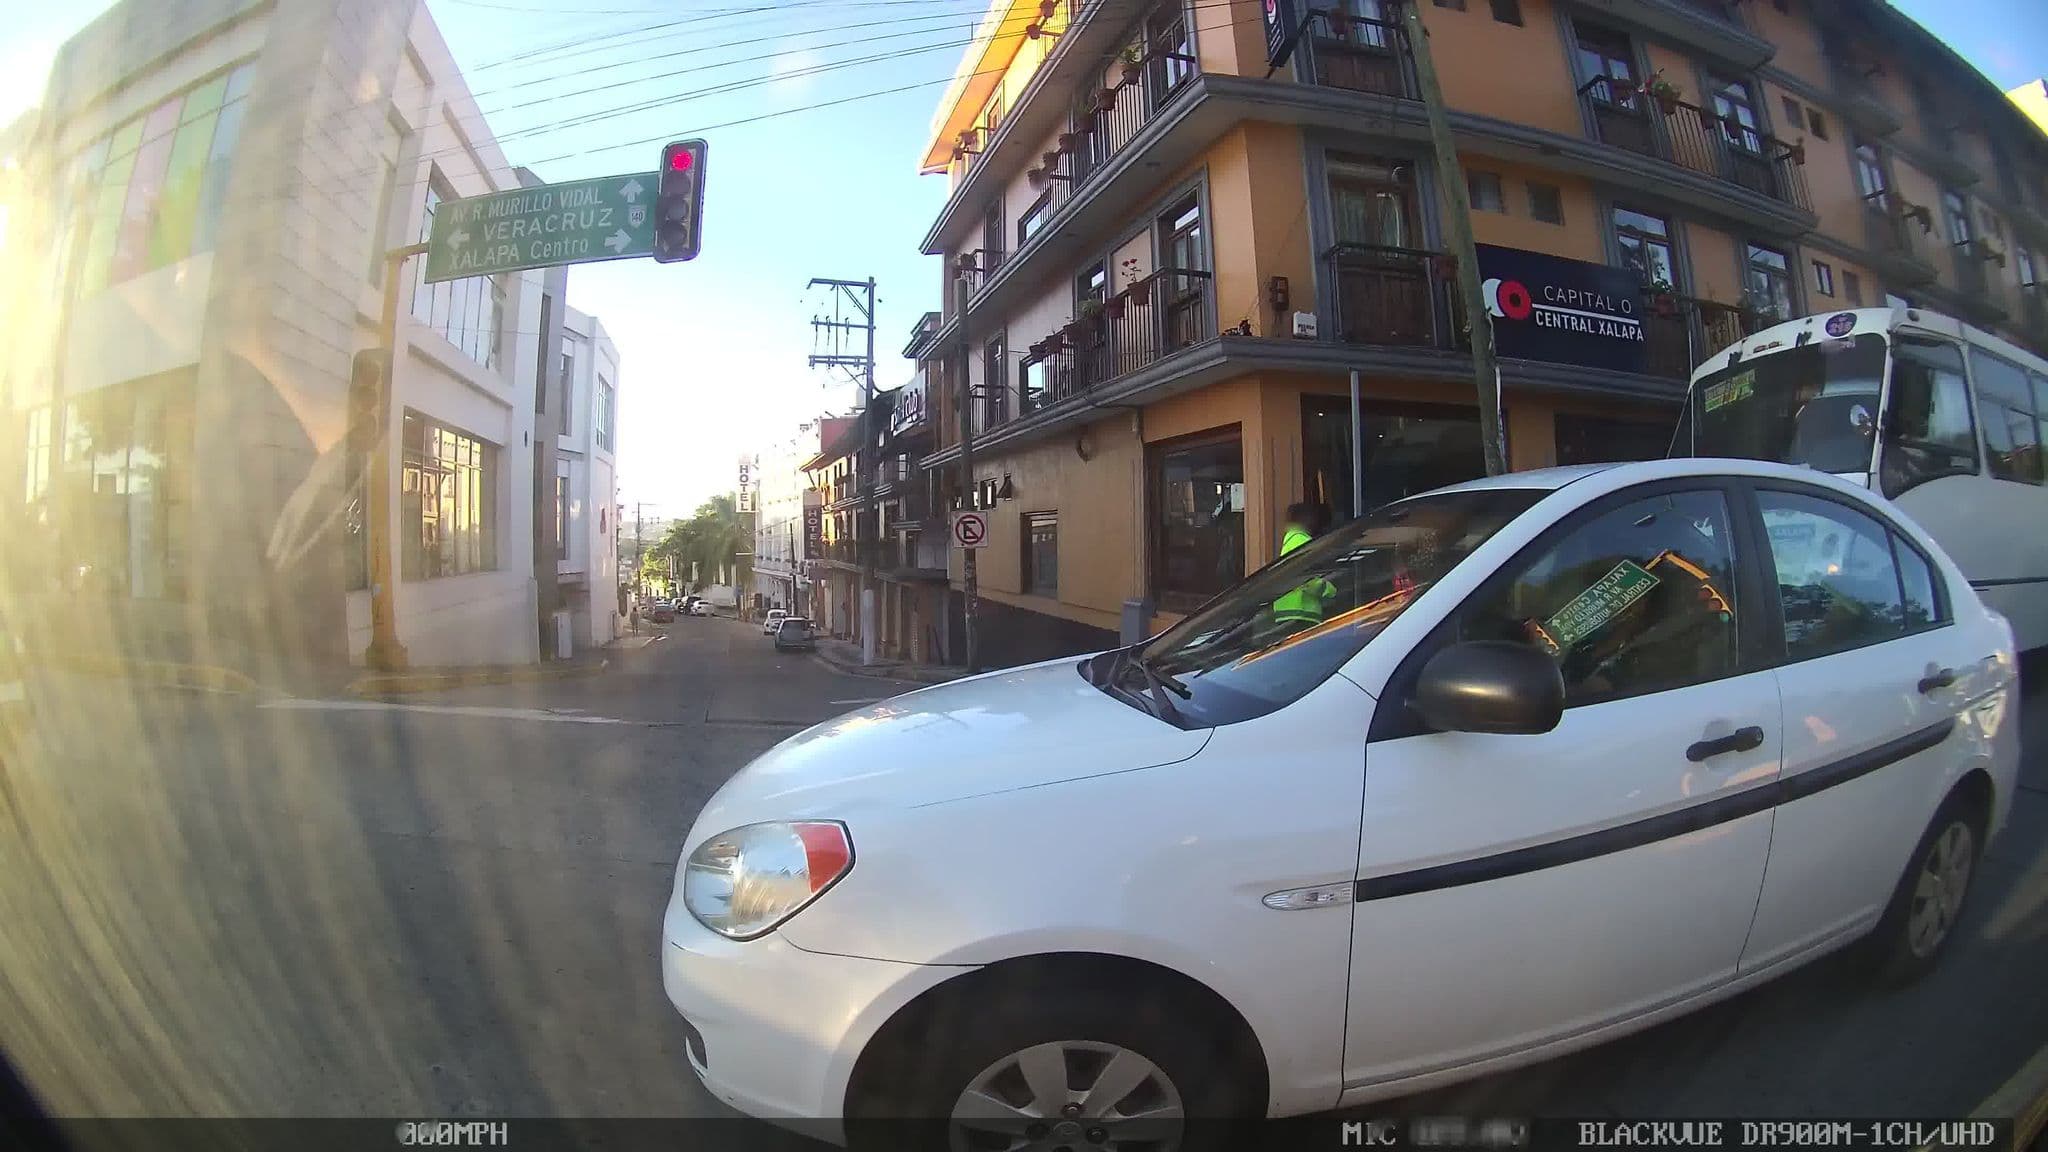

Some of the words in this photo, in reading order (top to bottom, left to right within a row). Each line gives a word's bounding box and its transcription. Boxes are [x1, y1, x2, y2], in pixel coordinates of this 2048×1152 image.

[487, 192, 553, 219] MURILLO
[559, 186, 604, 209] VIDAL
[483, 207, 614, 241] VERACRUZ
[449, 242, 521, 271] XALAPA
[529, 237, 589, 260] Centro
[1543, 285, 1616, 312] CAPITAL
[1621, 299, 1633, 314] O
[1535, 310, 1596, 335] CENTRAL
[1598, 320, 1645, 342] XALAPA
[739, 464, 749, 511] HOTEL
[808, 510, 818, 548] HOTEL
[961, 520, 977, 539] E
